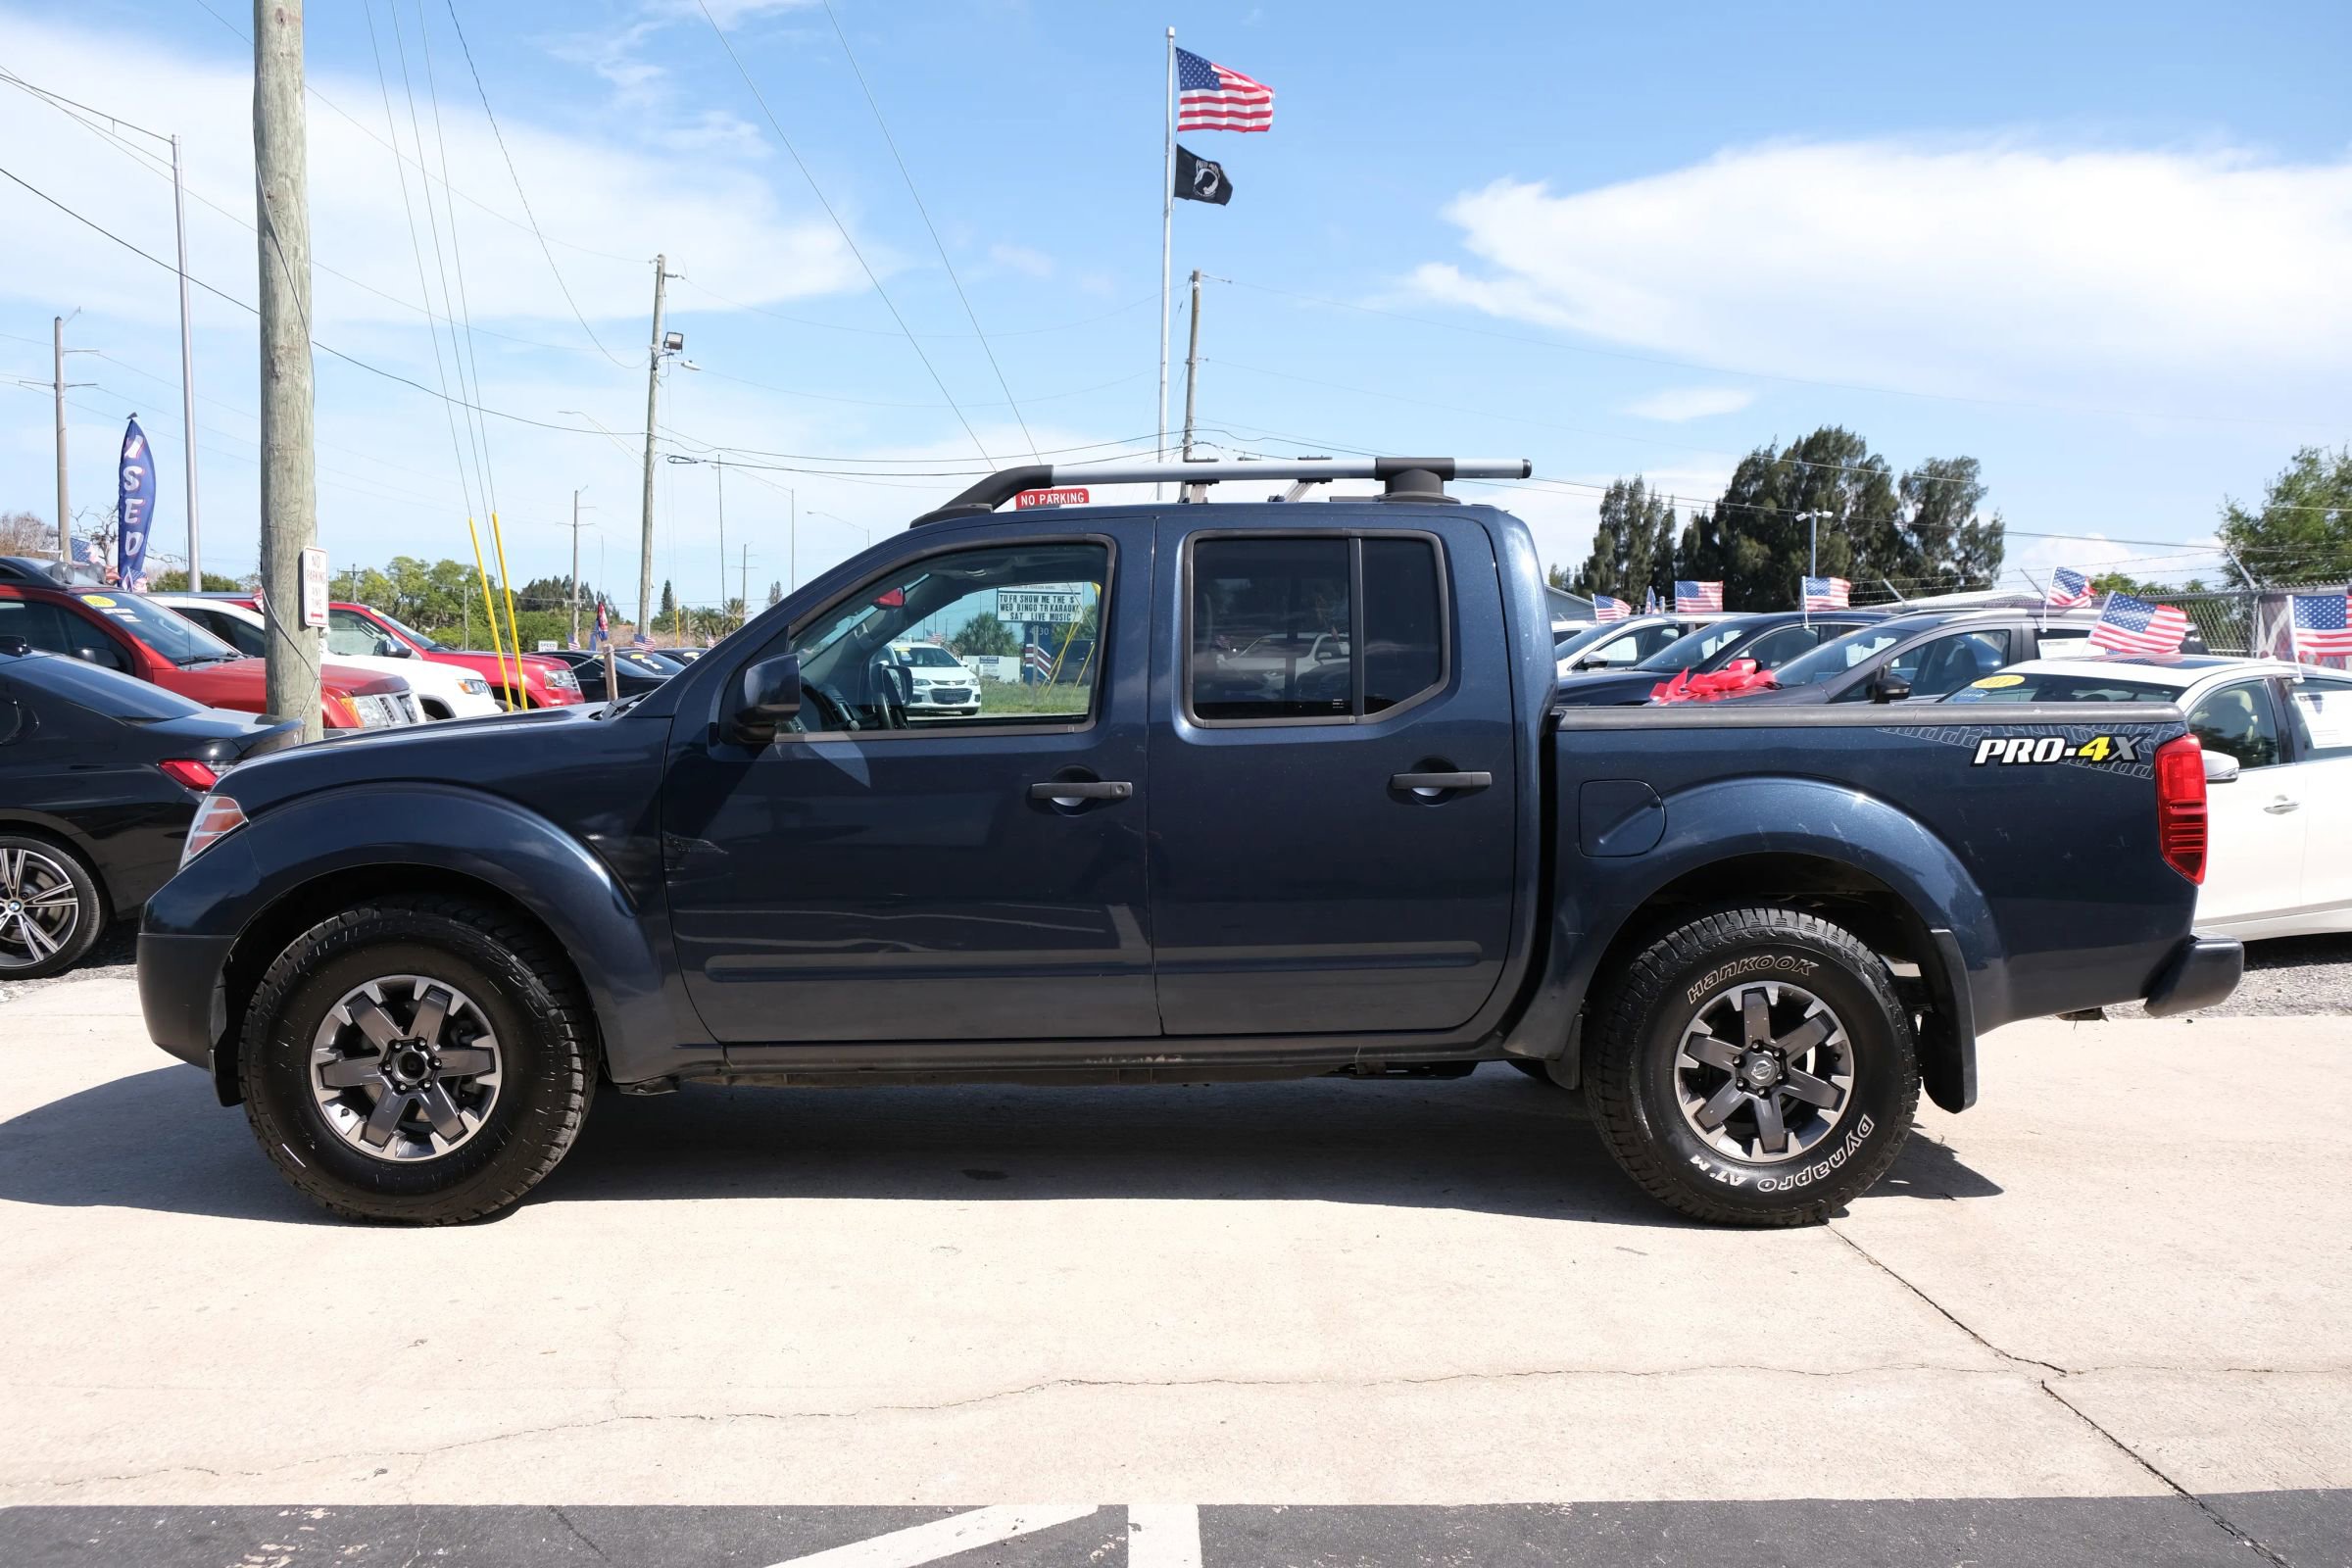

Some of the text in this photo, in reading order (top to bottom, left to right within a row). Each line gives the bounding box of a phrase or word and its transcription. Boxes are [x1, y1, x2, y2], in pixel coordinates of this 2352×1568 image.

[1020, 492, 1084, 507] NO PARKING
[312, 556, 320, 568] NO
[306, 568, 326, 585] PARKING
[312, 586, 321, 597] ANY
[1019, 594, 1039, 603] SHOW
[1041, 595, 1050, 604] ME
[1053, 595, 1065, 604] THE
[1000, 603, 1013, 612] WED
[1016, 603, 1038, 612] BINGO
[1009, 612, 1071, 621] SAT LIVE MUSIC
[1973, 735, 2146, 765] PRO-4X
